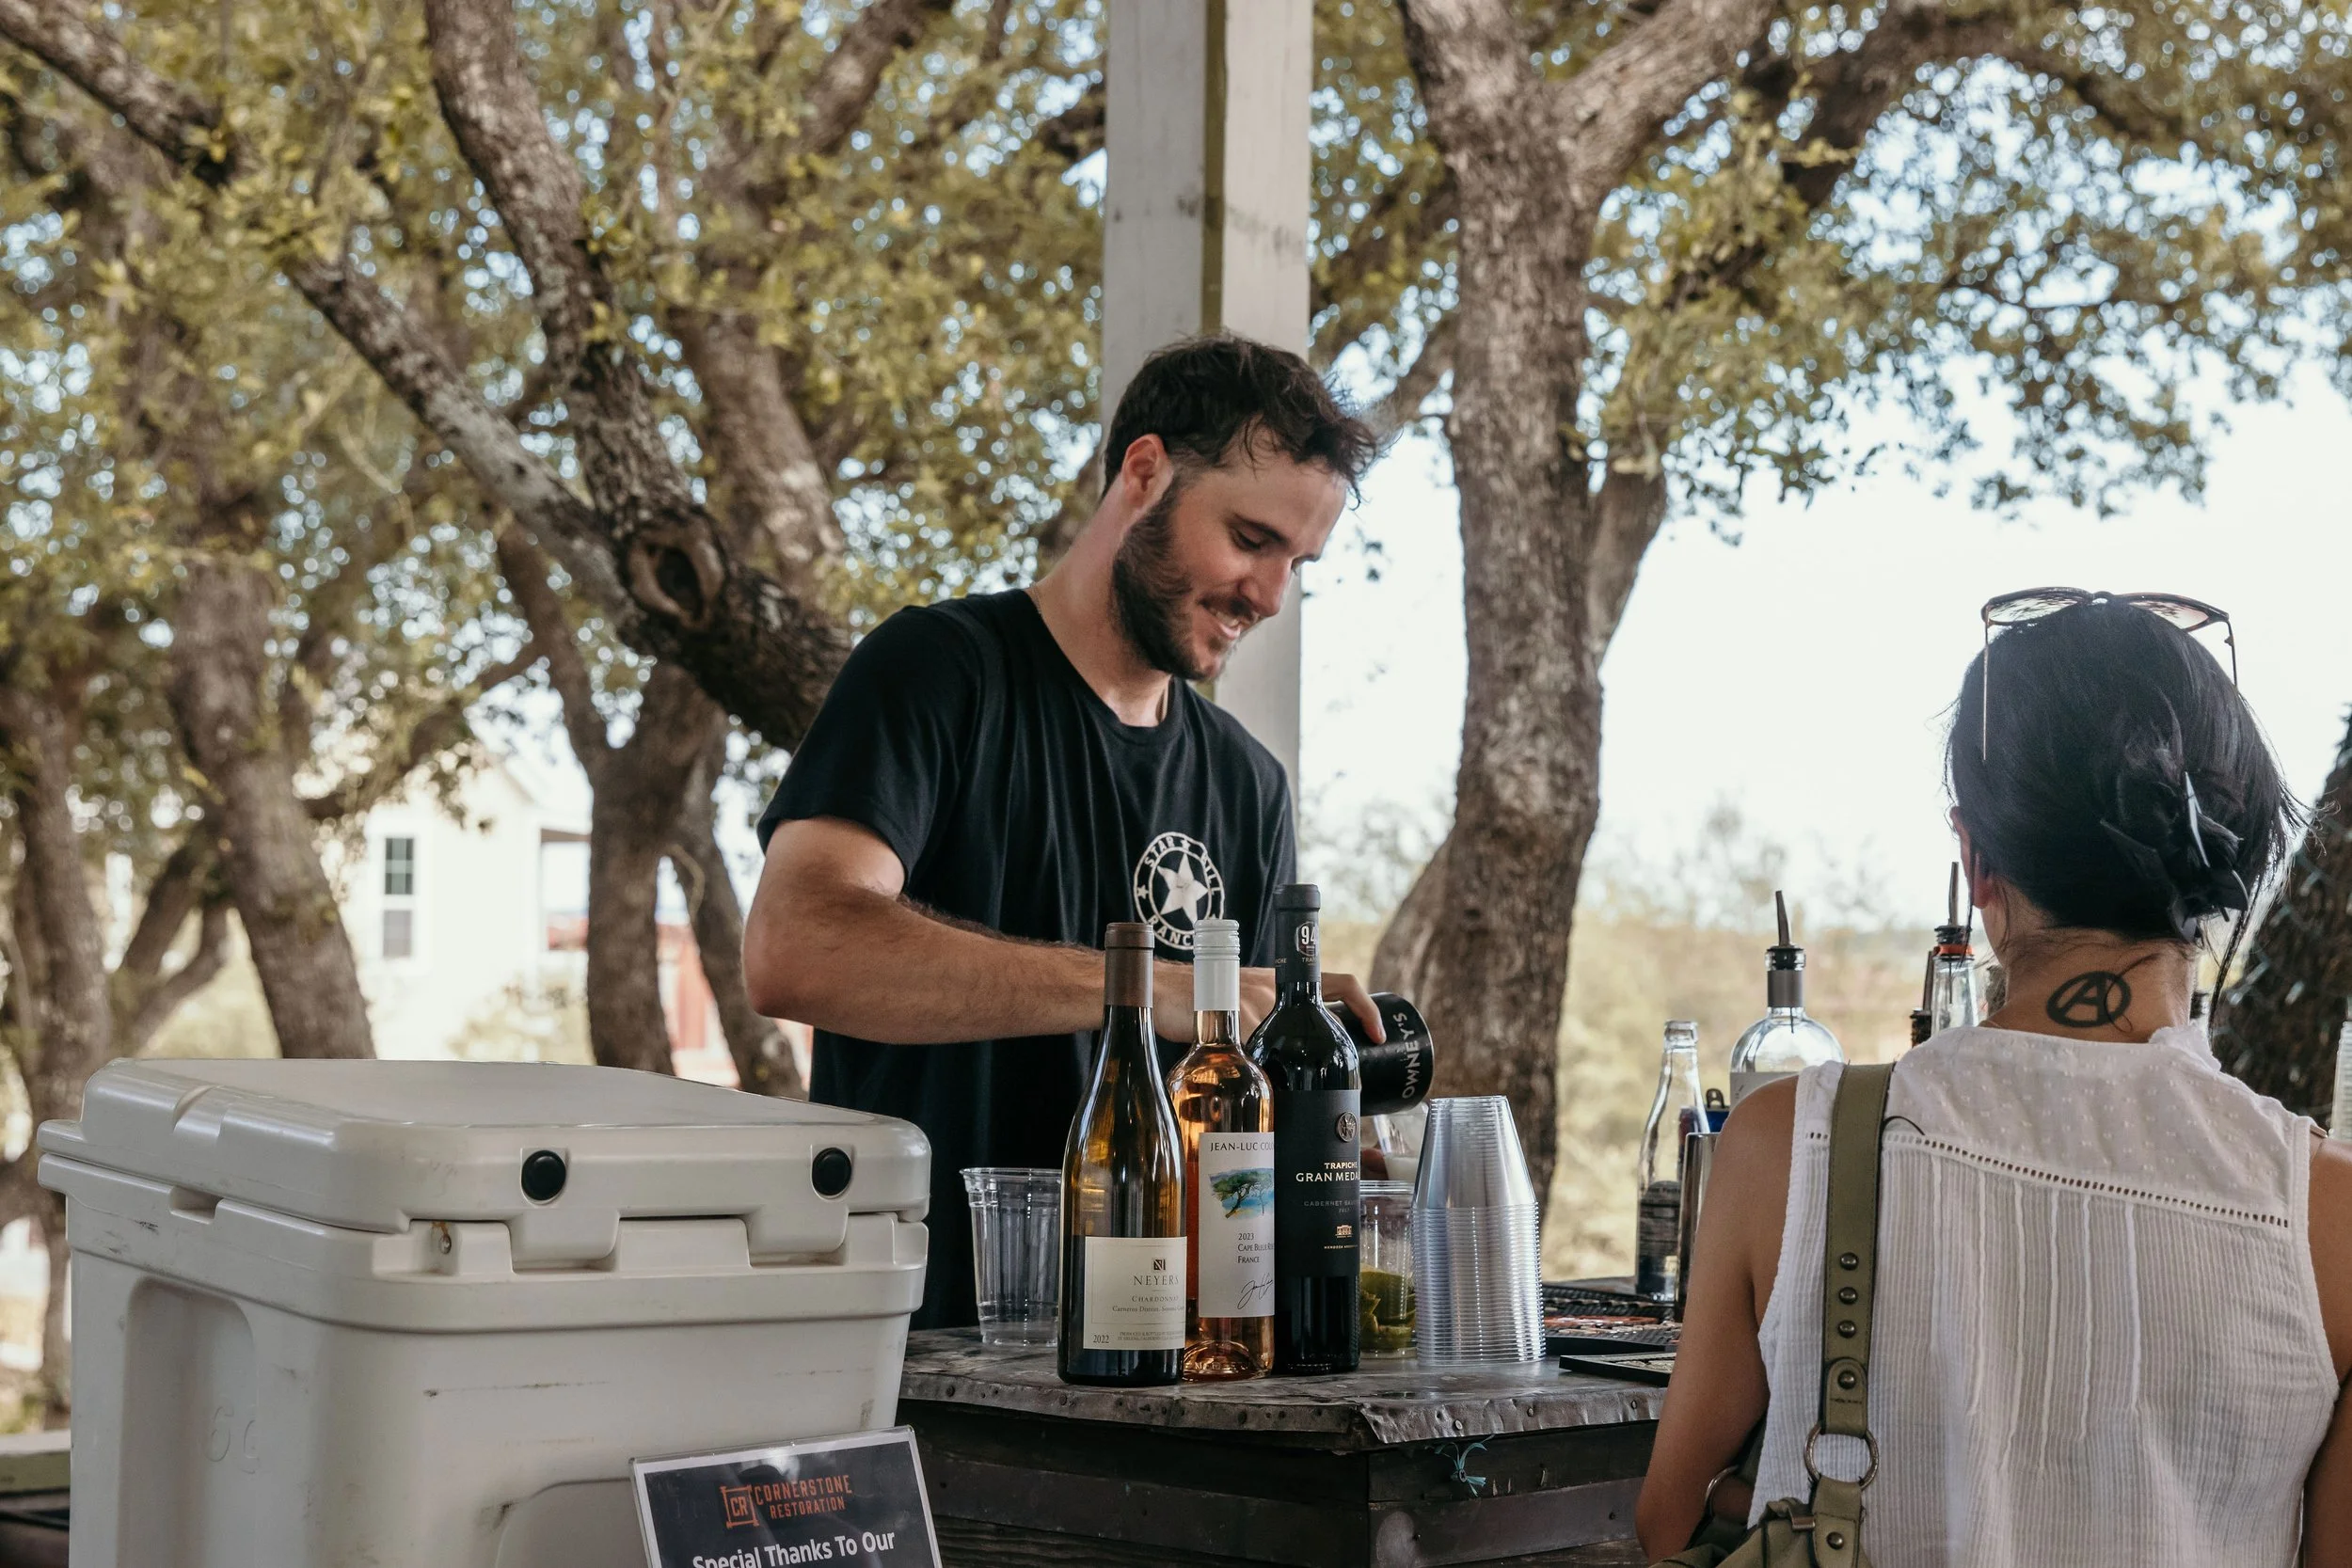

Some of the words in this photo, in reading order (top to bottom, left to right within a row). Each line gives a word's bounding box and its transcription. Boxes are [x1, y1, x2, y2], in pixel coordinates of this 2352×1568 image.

[1144, 835, 1176, 868] STAR
[1147, 914, 1193, 946] RANC
[1301, 926, 1316, 945] 94
[1392, 1011, 1422, 1100] OWNEY'S
[1210, 1142, 1258, 1151] JEAN-LUC
[1295, 1172, 1332, 1182] GRAN
[1335, 1171, 1360, 1181] MEDA
[1238, 1232, 1255, 1241] 2023
[1237, 1243, 1253, 1252] CAPE
[1237, 1255, 1260, 1264] FRANCE
[1133, 1275, 1179, 1286] NEYERS
[1092, 1334, 1109, 1344] 2022
[754, 1474, 853, 1506] CORNERSTONE
[730, 1496, 749, 1517] CR
[770, 1497, 846, 1520] RESTORATION
[692, 1547, 762, 1568] Special
[767, 1537, 833, 1568] Thanks
[834, 1535, 858, 1558] To
[862, 1529, 897, 1553] Our
